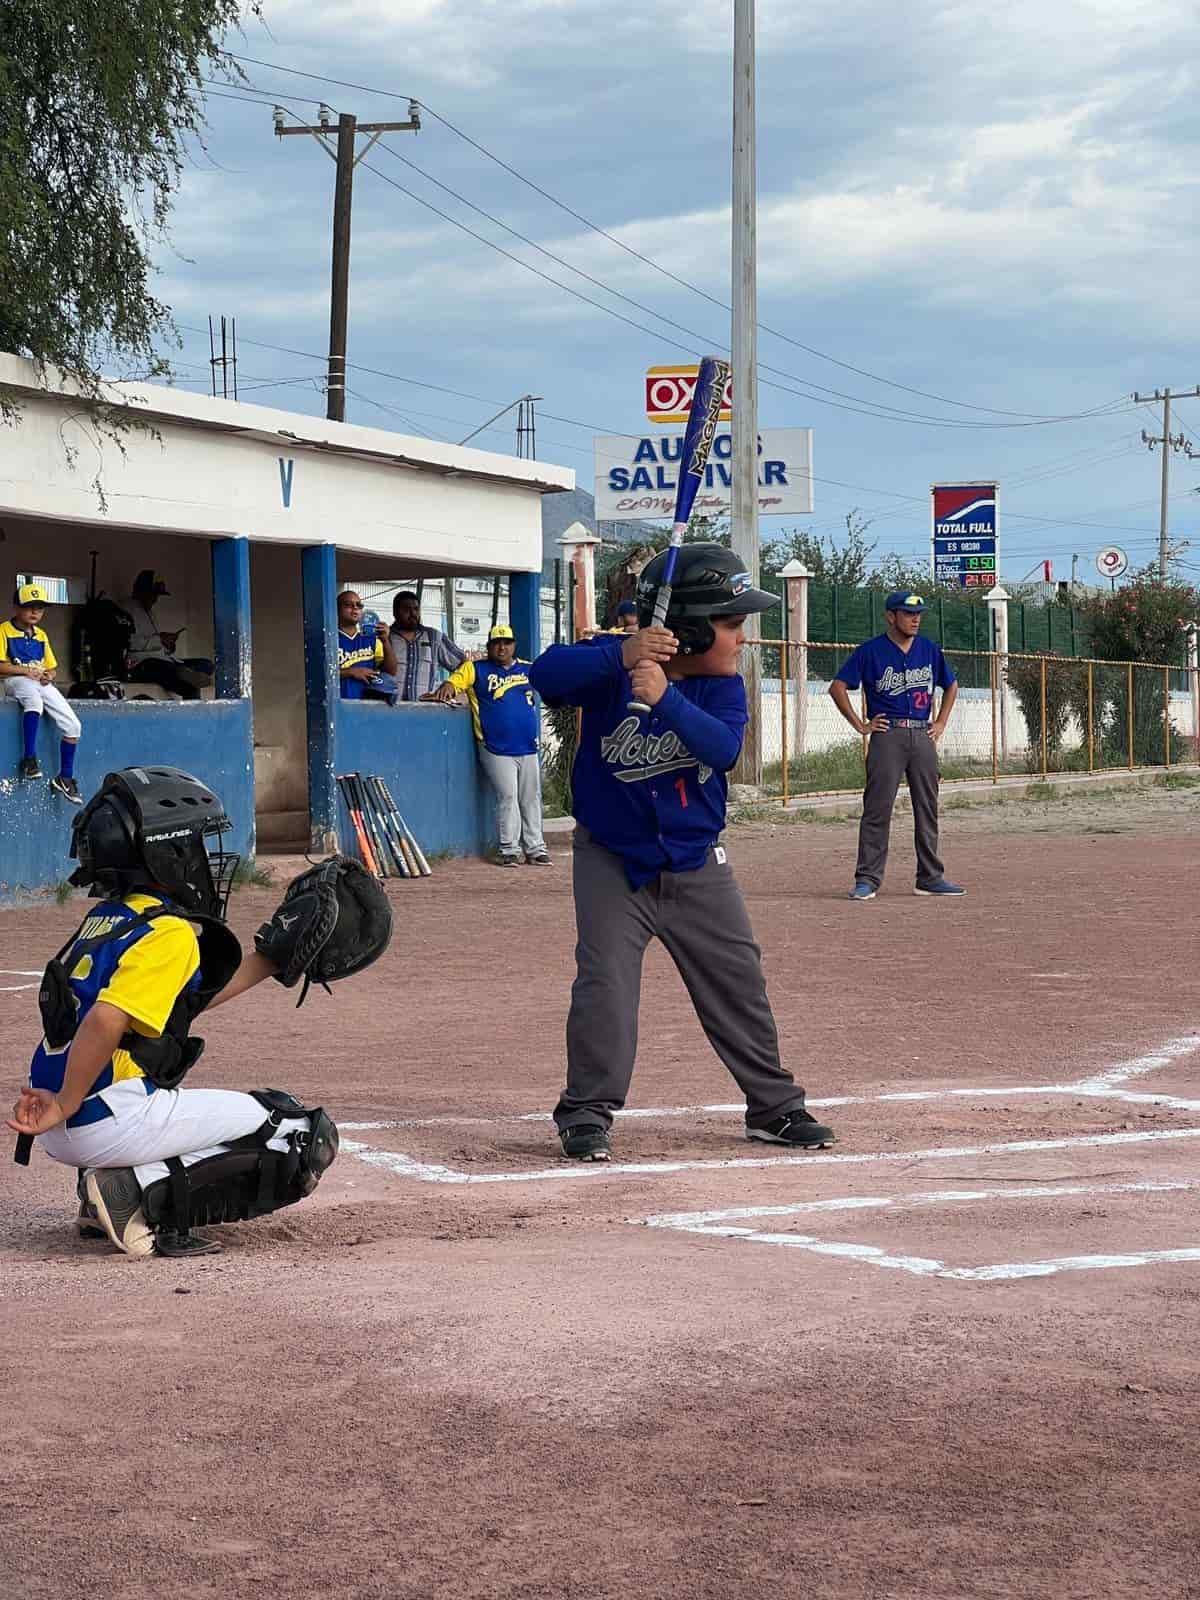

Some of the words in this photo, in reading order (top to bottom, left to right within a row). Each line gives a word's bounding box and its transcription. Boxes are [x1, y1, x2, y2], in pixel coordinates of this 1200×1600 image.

[650, 378, 732, 411] OX
[633, 434, 762, 463] AUO
[608, 461, 787, 491] SALIVR
[937, 524, 967, 534] TOTAL
[969, 522, 993, 533] FULL
[913, 691, 929, 710] 21
[674, 777, 689, 809] 1
